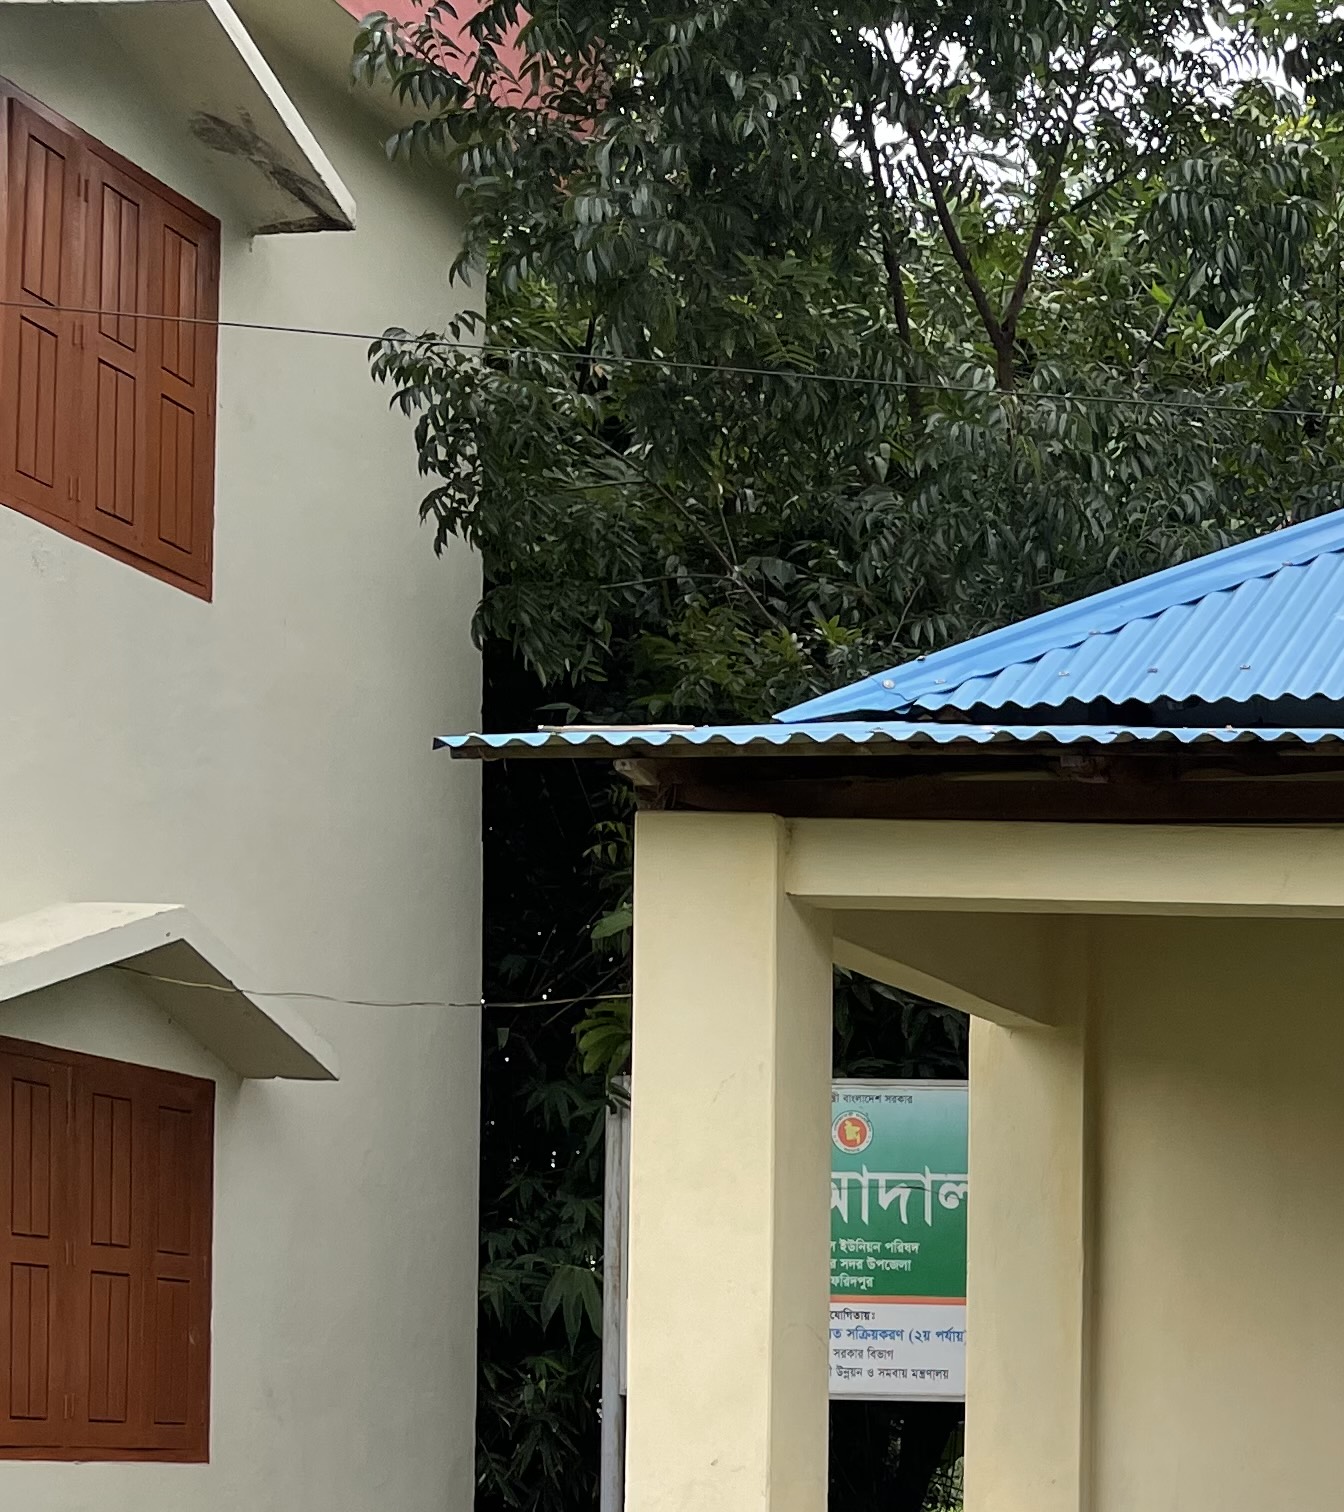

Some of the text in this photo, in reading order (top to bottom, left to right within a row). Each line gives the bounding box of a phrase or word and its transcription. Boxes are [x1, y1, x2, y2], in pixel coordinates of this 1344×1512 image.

[839, 1238, 920, 1254] ইউনিয়ন পরিষদ
[840, 1256, 911, 1271] সদর উপজেলা
